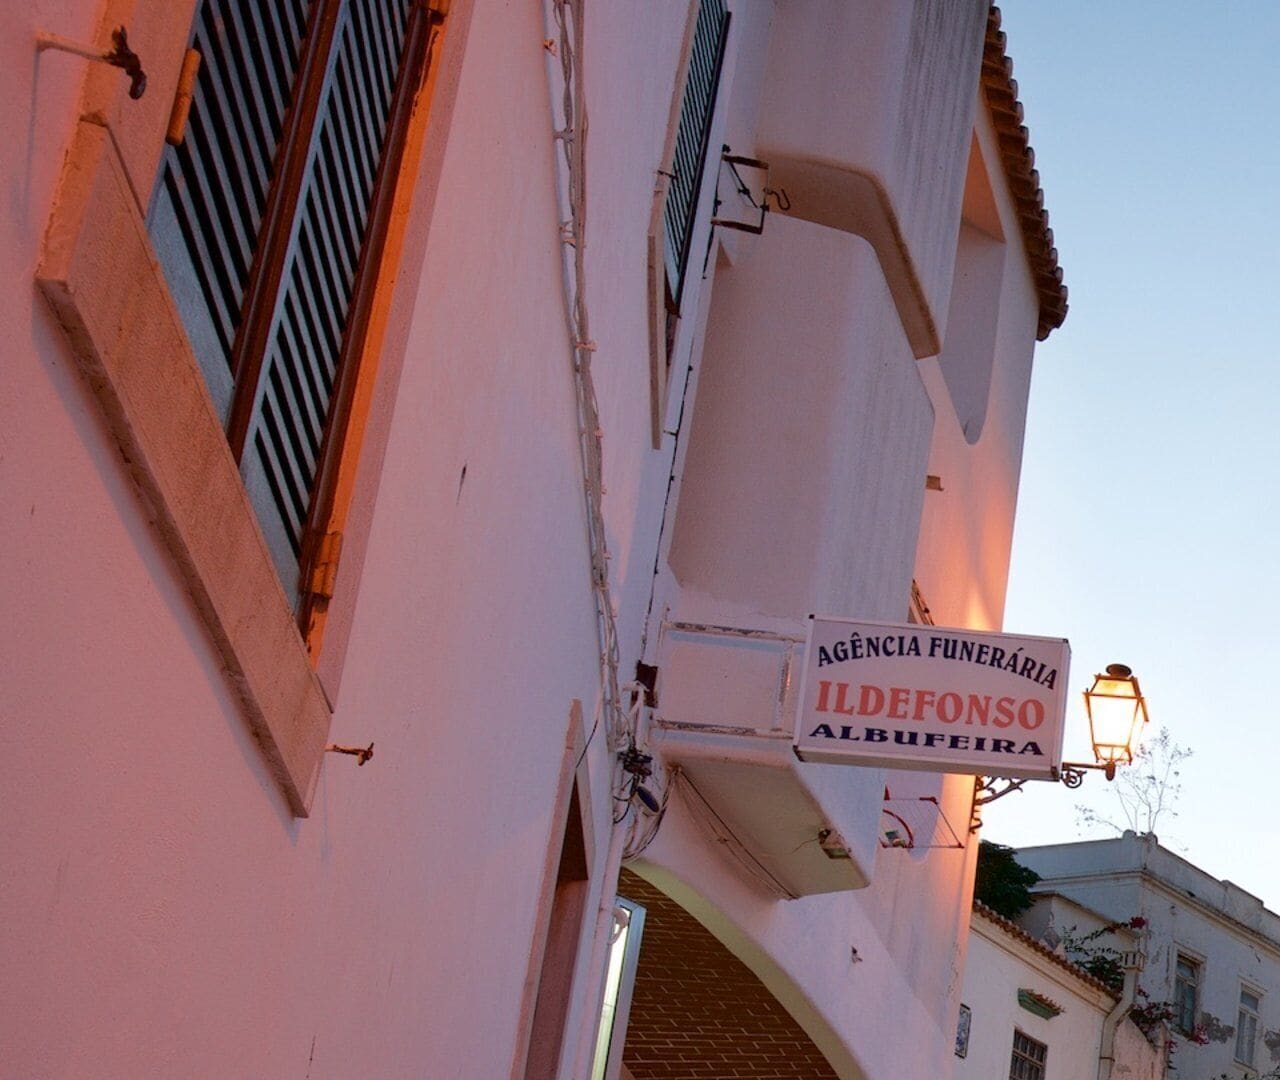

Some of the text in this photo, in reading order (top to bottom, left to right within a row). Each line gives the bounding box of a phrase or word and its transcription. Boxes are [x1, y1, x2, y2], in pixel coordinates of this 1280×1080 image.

[818, 632, 1058, 690] AGÊNCIA FUNERÁRIA
[815, 681, 1045, 730] ILDEFONSO
[809, 723, 1045, 755] ALBUFEIRA
